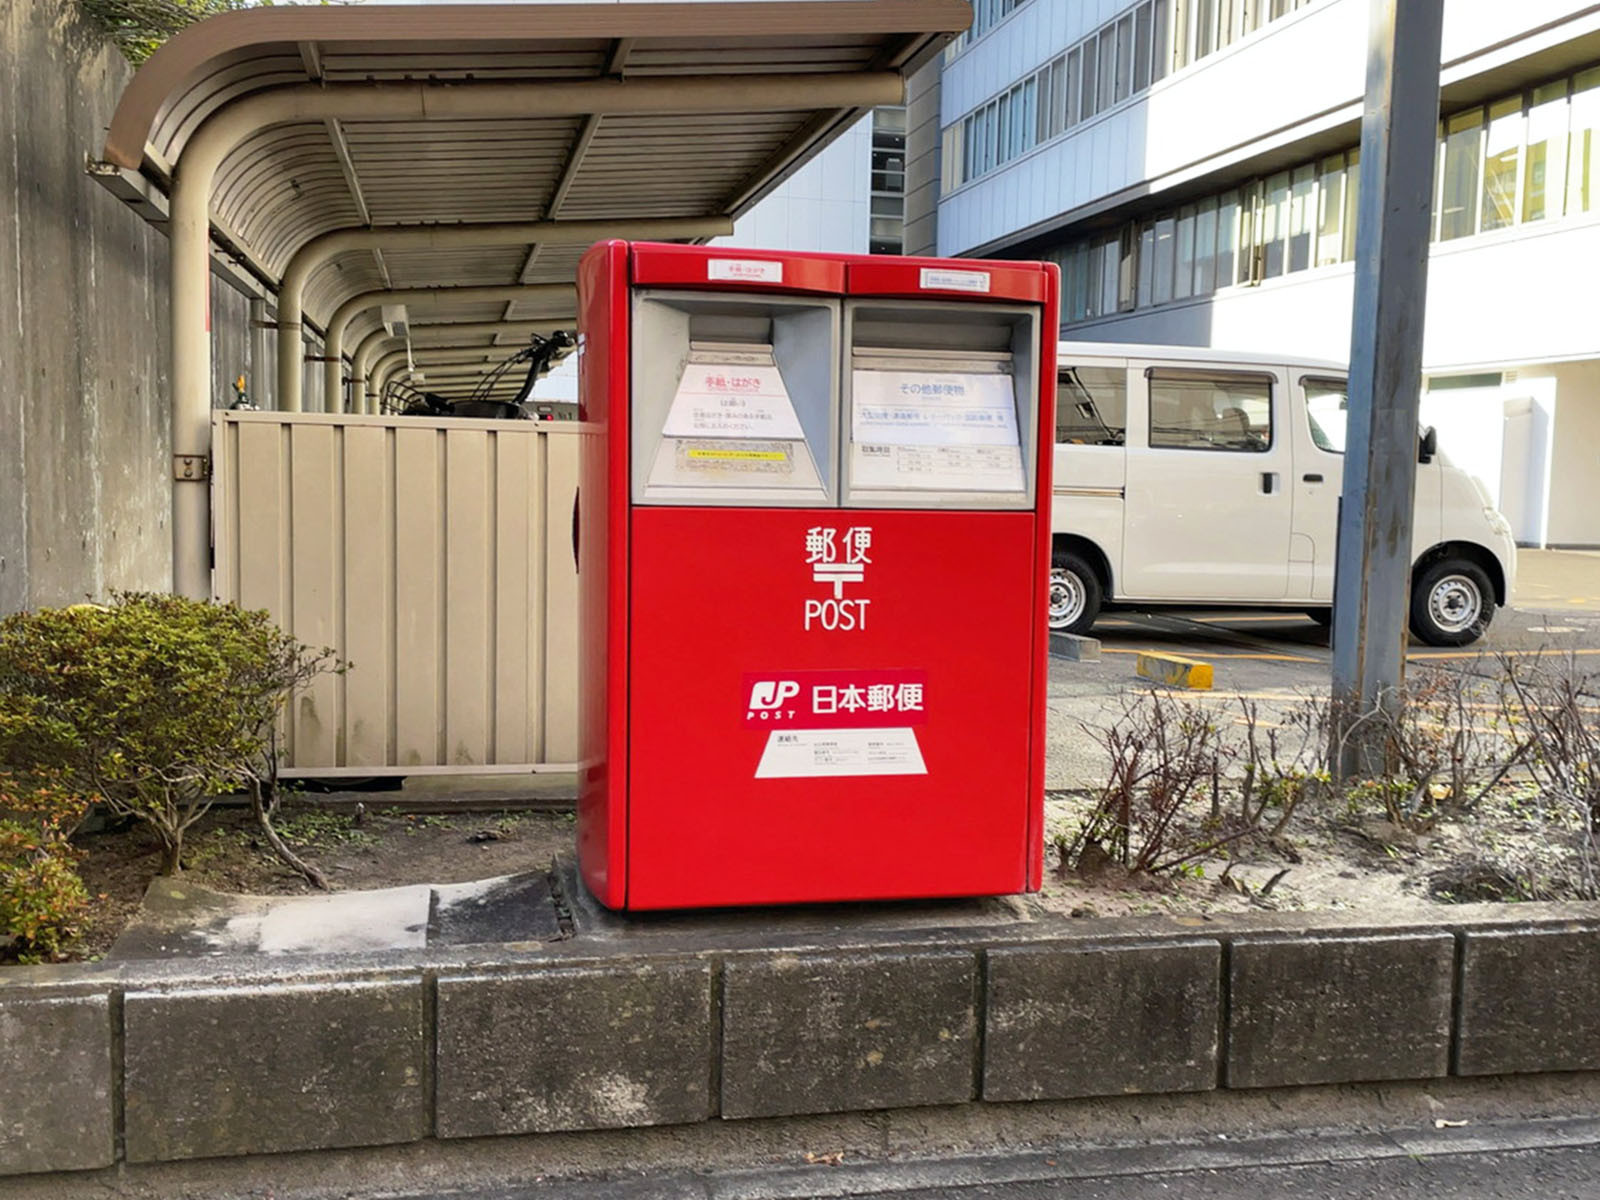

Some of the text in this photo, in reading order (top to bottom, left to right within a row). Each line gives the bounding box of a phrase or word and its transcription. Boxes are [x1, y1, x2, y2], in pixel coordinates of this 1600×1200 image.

[900, 384, 965, 396] その他郵便物
[805, 526, 872, 564] 郵便
[805, 599, 871, 631] POST
[749, 681, 800, 710] JP
[812, 683, 924, 714] 日本郵便
[747, 711, 796, 720] POST
